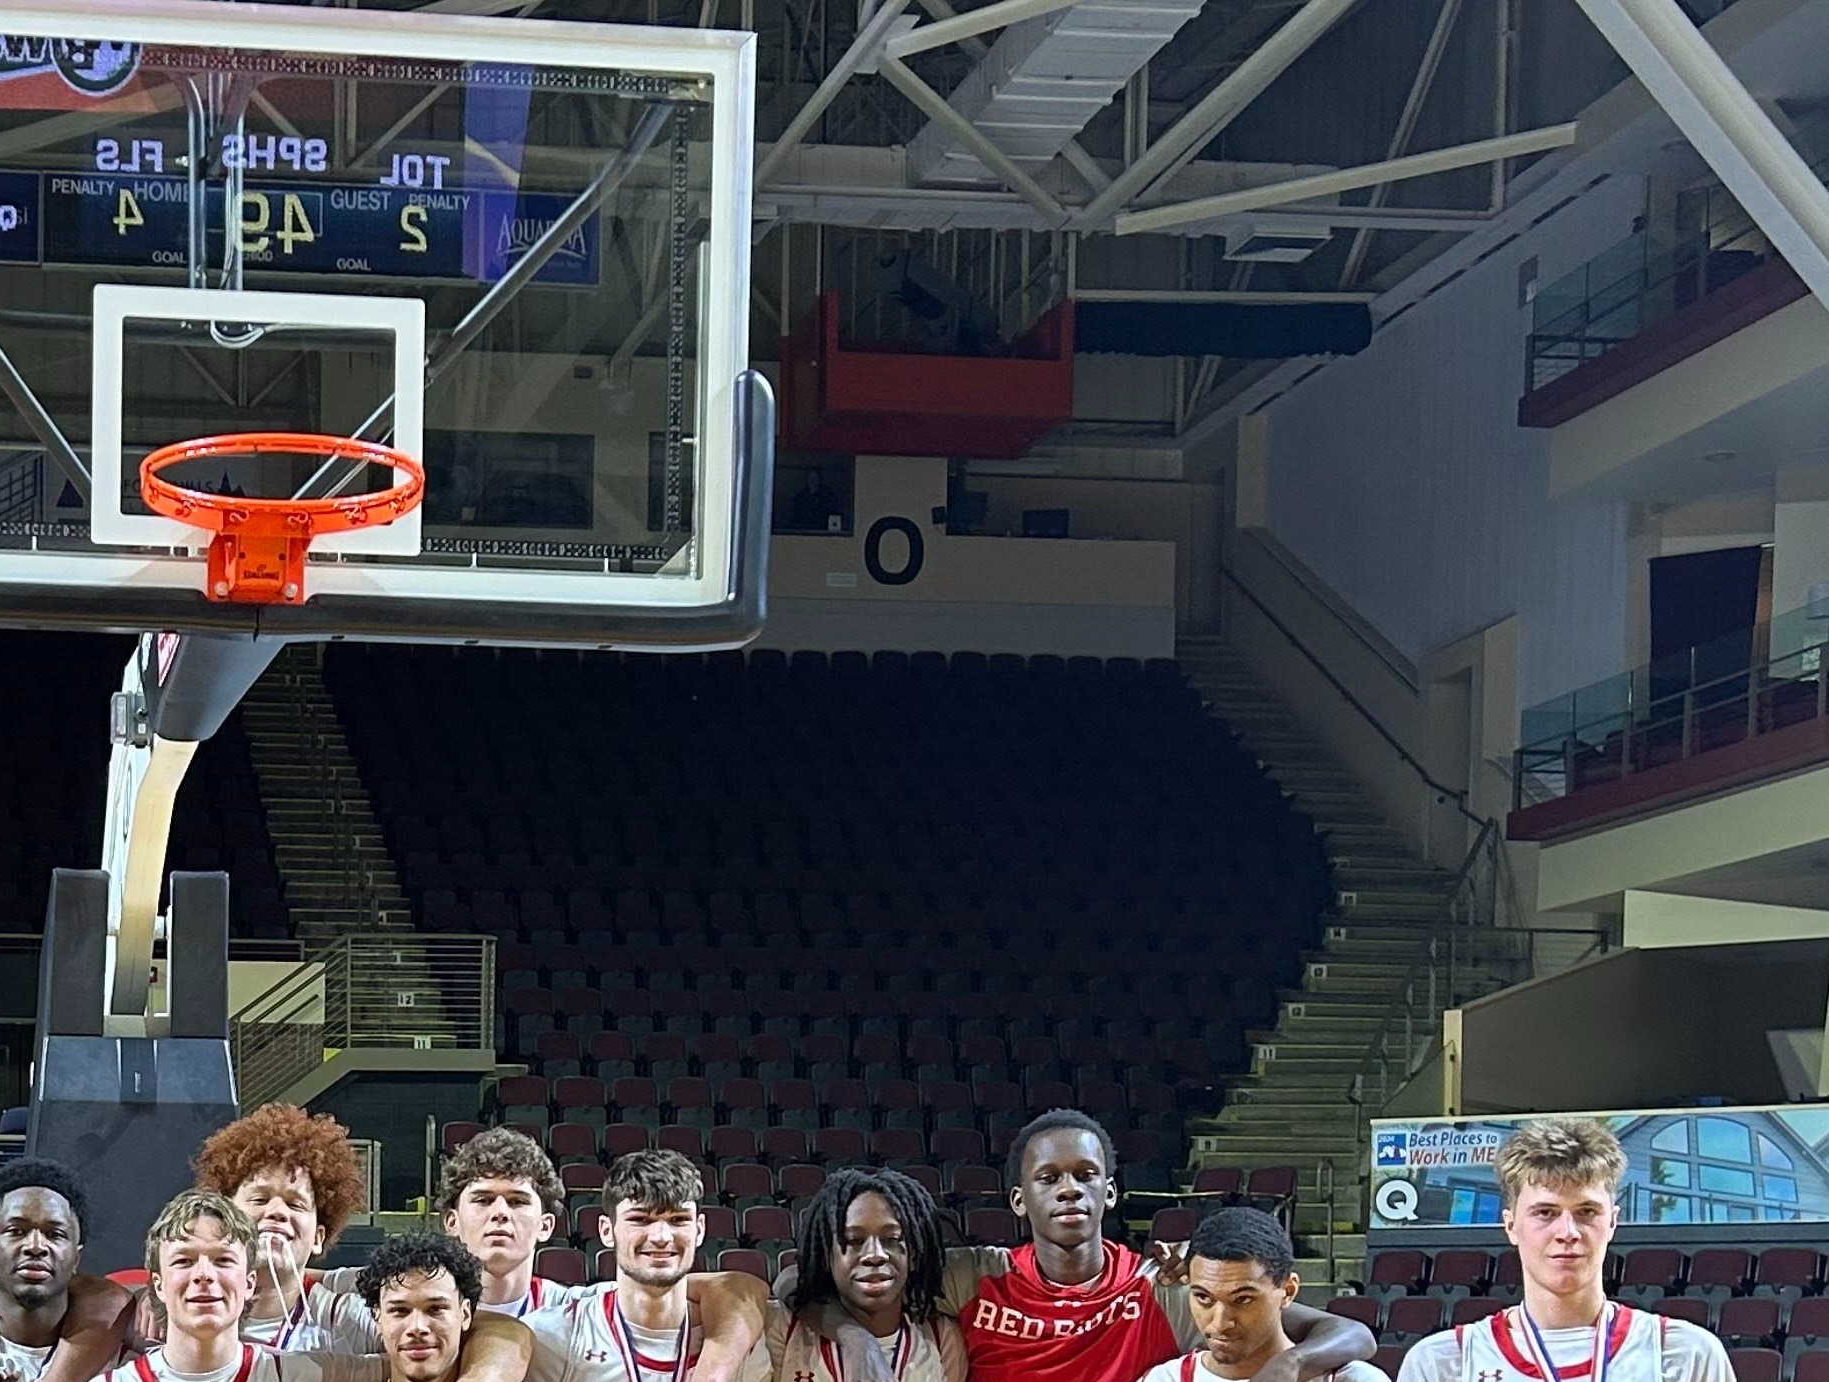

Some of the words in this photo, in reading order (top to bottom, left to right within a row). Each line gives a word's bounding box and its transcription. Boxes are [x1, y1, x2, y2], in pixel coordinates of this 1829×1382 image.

[51, 177, 115, 197] PENALTY
[330, 189, 391, 211] GUEST
[408, 193, 471, 211] PENALTY
[151, 250, 188, 264] GOAL
[336, 259, 371, 272] GOAL
[863, 515, 925, 586] O
[1408, 1132, 1437, 1148] Best
[1440, 1132, 1483, 1147] Places
[1486, 1133, 1498, 1144] to
[1408, 1148, 1450, 1165] Work
[1453, 1148, 1468, 1164] in
[1471, 1146, 1496, 1163] ME
[1375, 1179, 1419, 1222] Q
[973, 1299, 1045, 1341] RED
